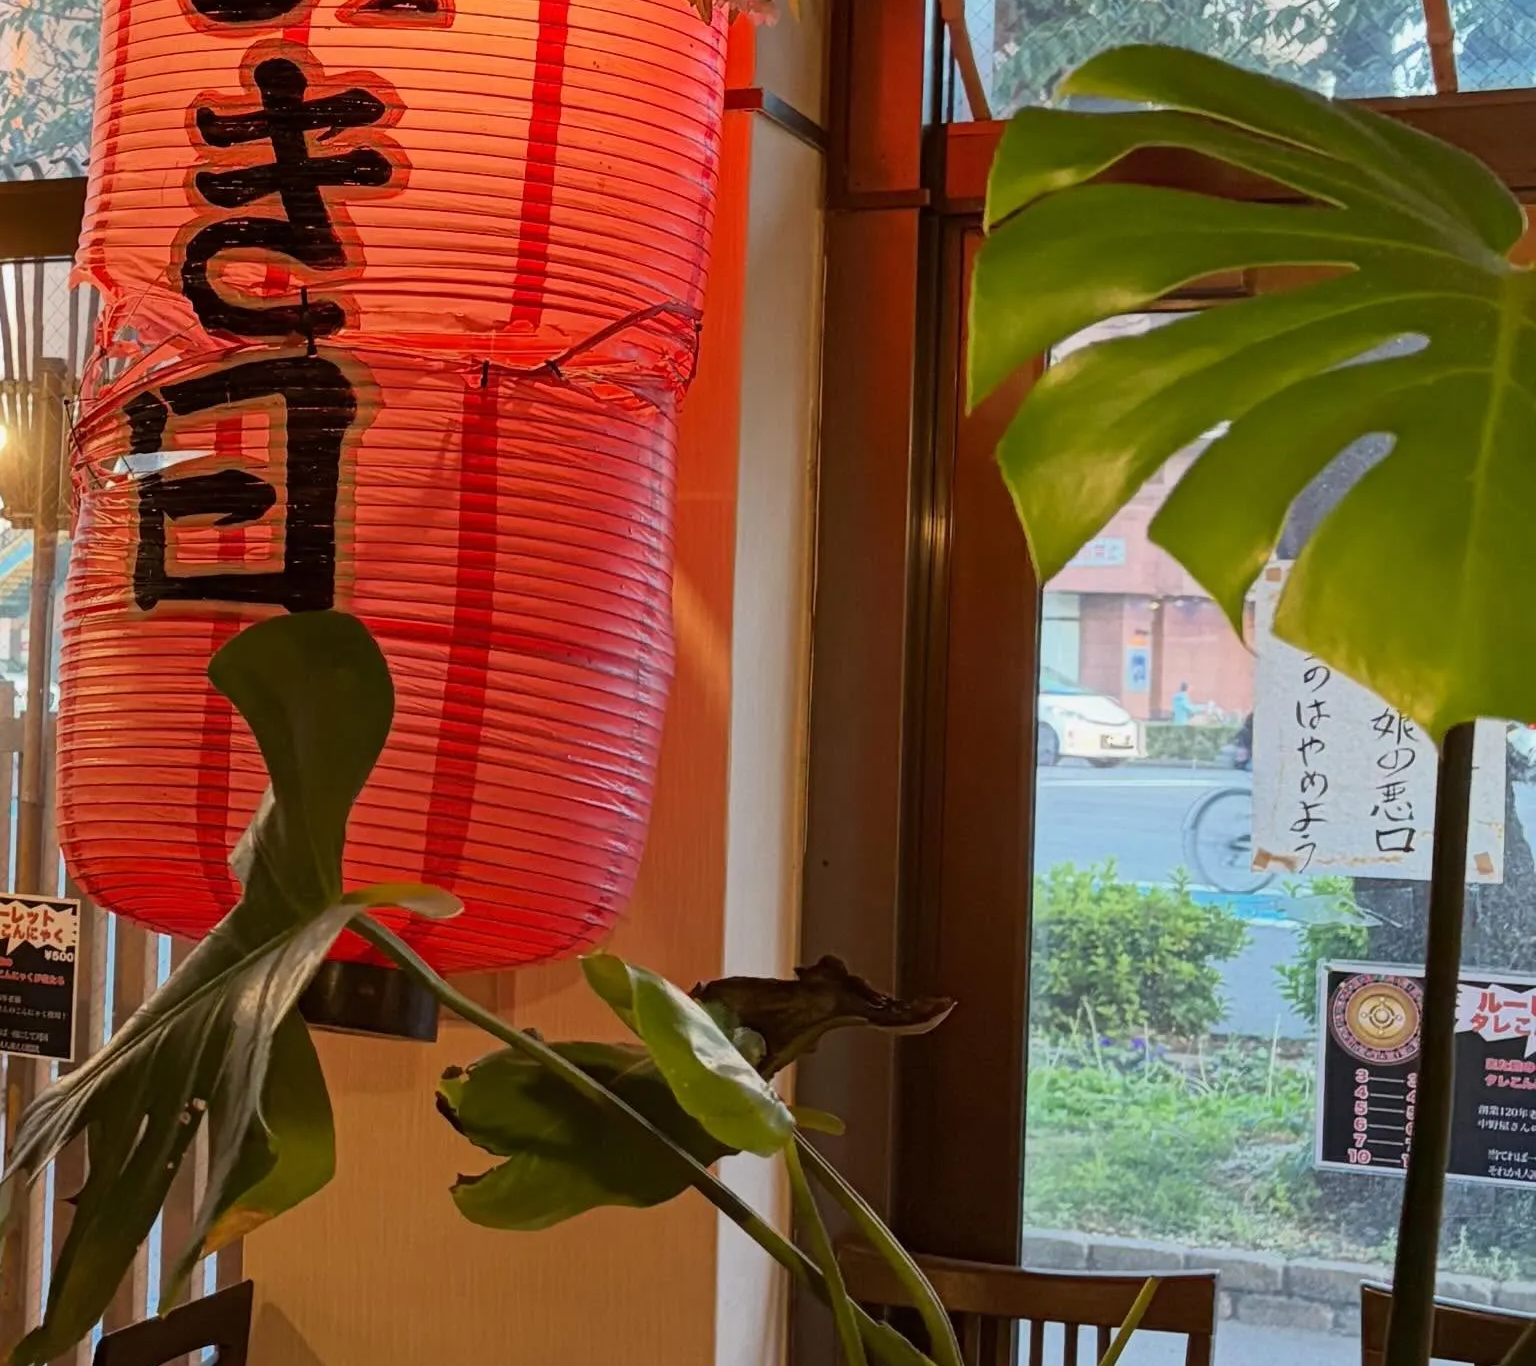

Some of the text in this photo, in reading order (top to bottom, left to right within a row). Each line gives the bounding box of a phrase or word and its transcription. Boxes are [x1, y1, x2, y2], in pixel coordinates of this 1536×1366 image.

[1290, 655, 1331, 873] のはやめよう
[44, 949, 74, 963] ¥500
[1478, 991, 1536, 1017] ルー
[1355, 1068, 1369, 1084] 3
[1354, 1085, 1368, 1100] 4
[1354, 1101, 1368, 1116] 5
[1353, 1117, 1368, 1132] 6
[1353, 1133, 1367, 1148] 7
[1347, 1149, 1371, 1164] 10
